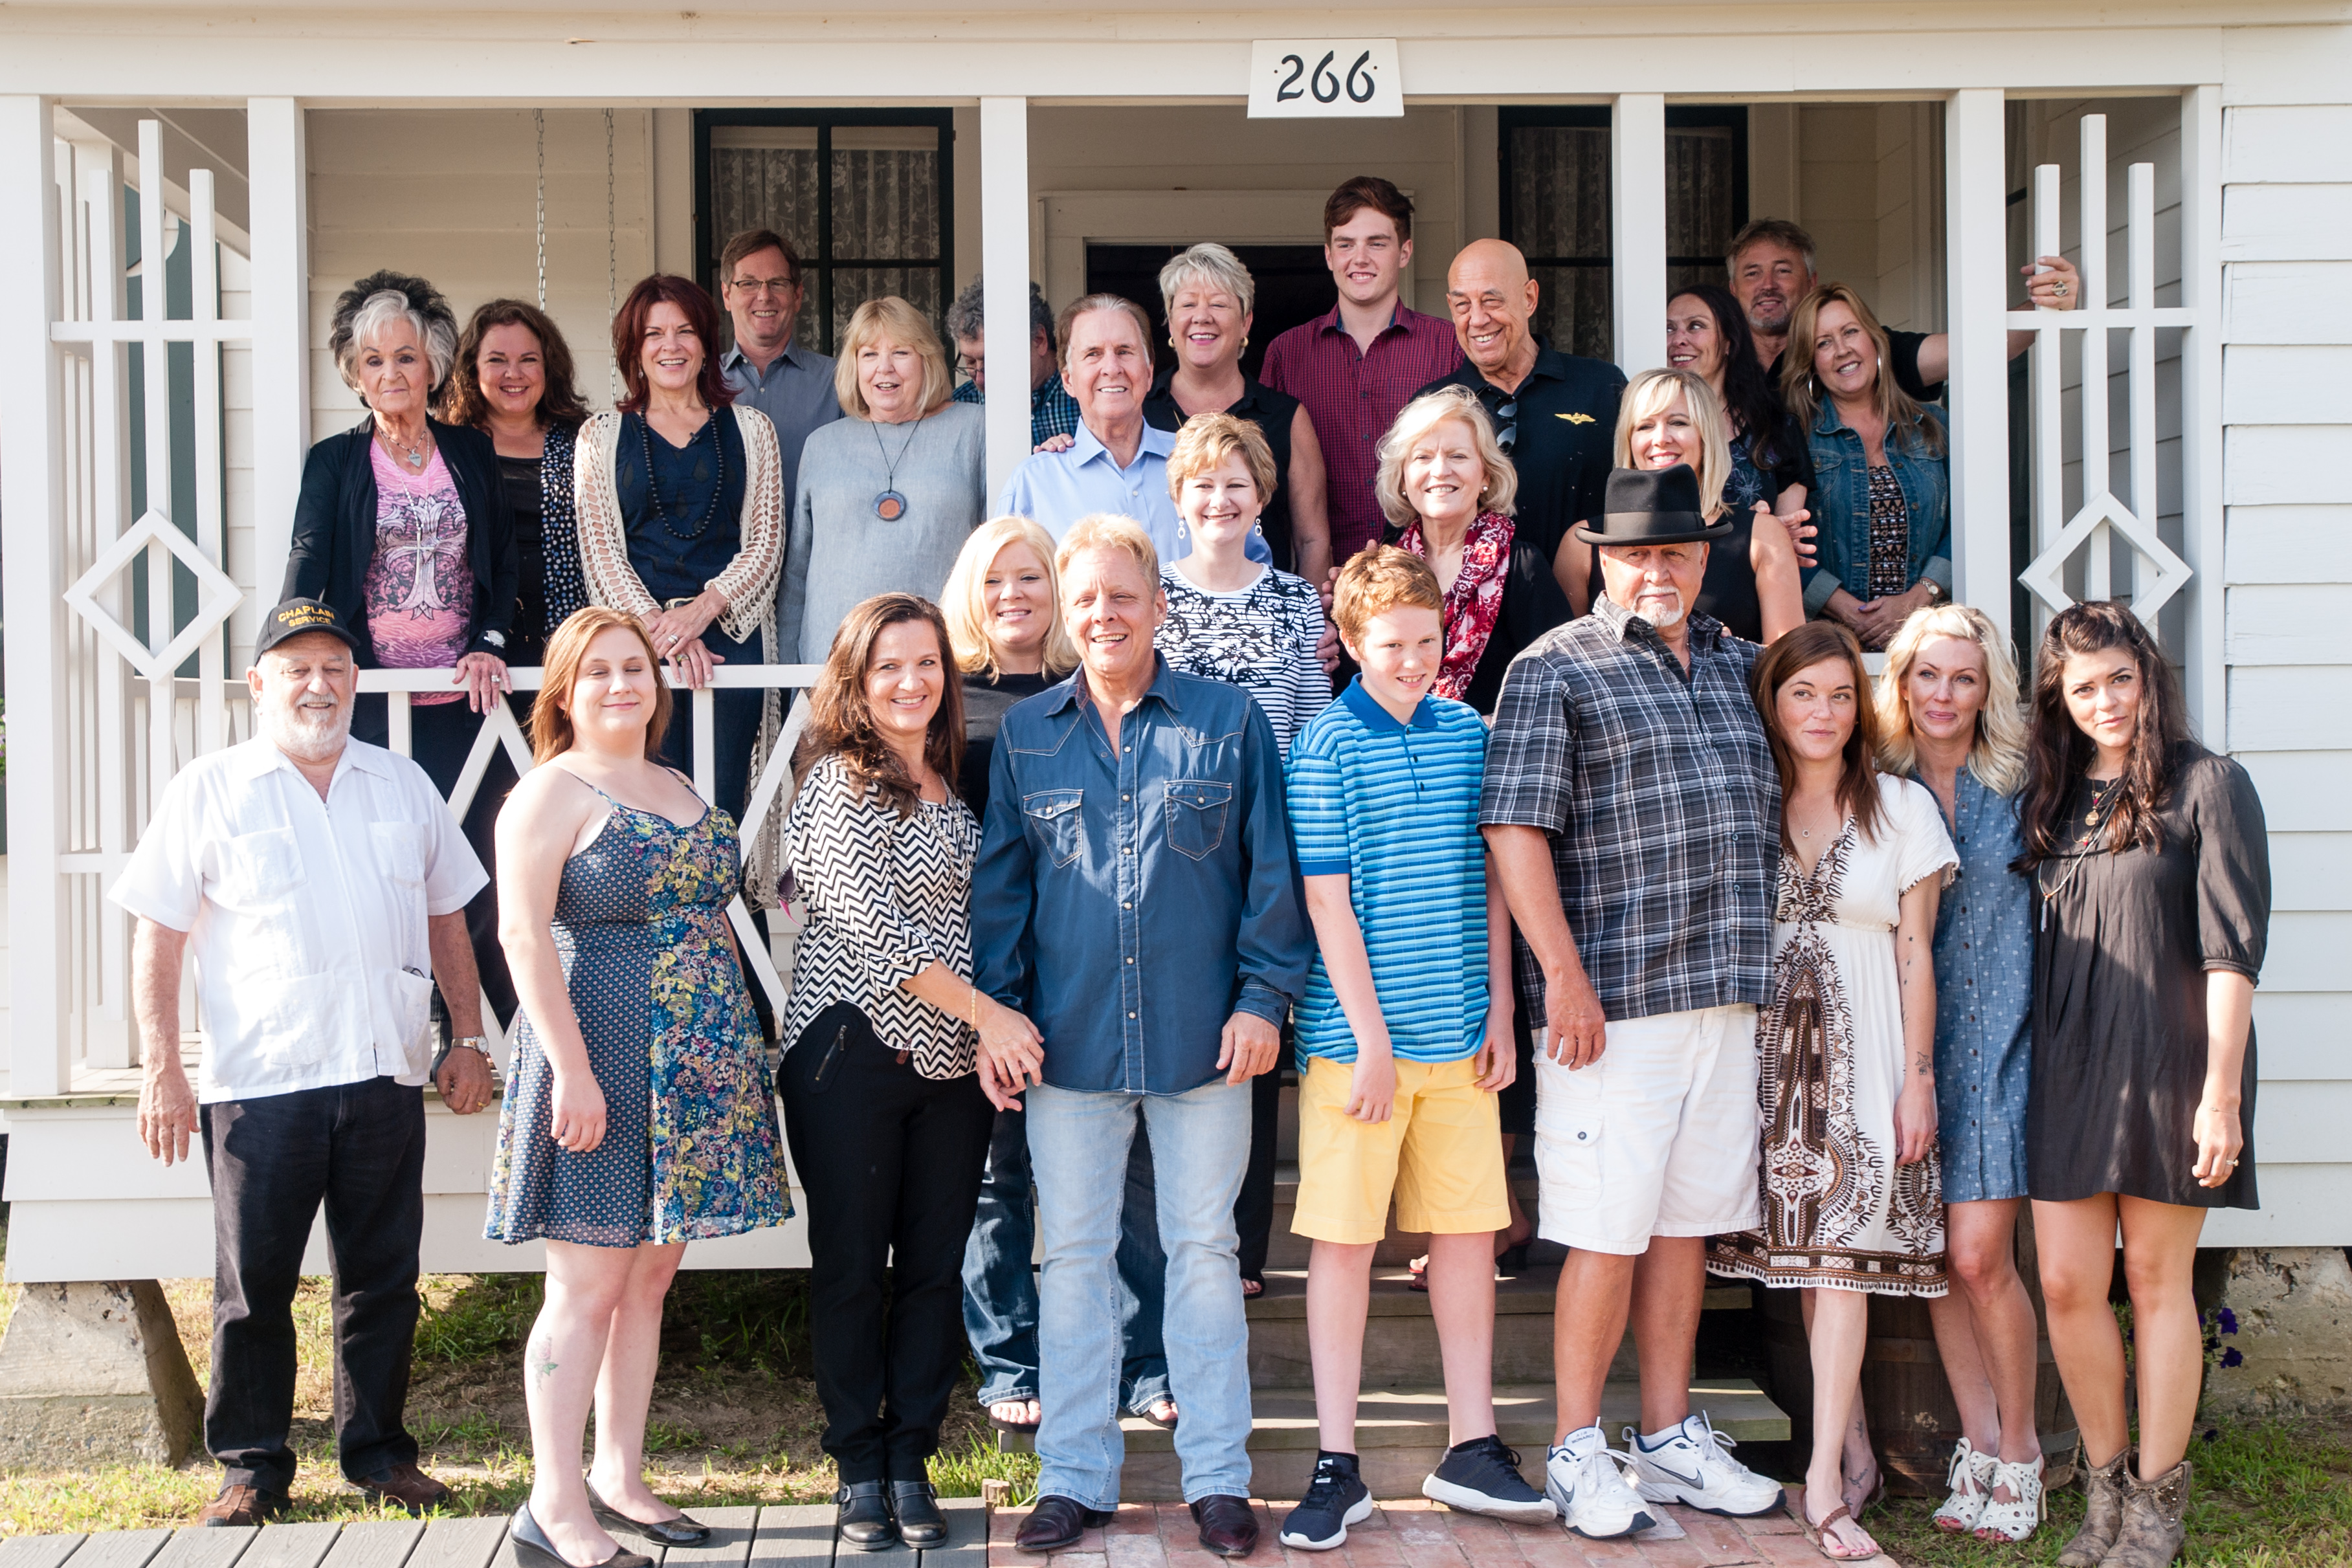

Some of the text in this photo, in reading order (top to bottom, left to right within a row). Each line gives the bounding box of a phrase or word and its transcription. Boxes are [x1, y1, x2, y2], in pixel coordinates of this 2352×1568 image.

[1277, 50, 1375, 103] 266
[278, 605, 335, 622] CHAPLAIN
[289, 616, 331, 626] SERVICE
